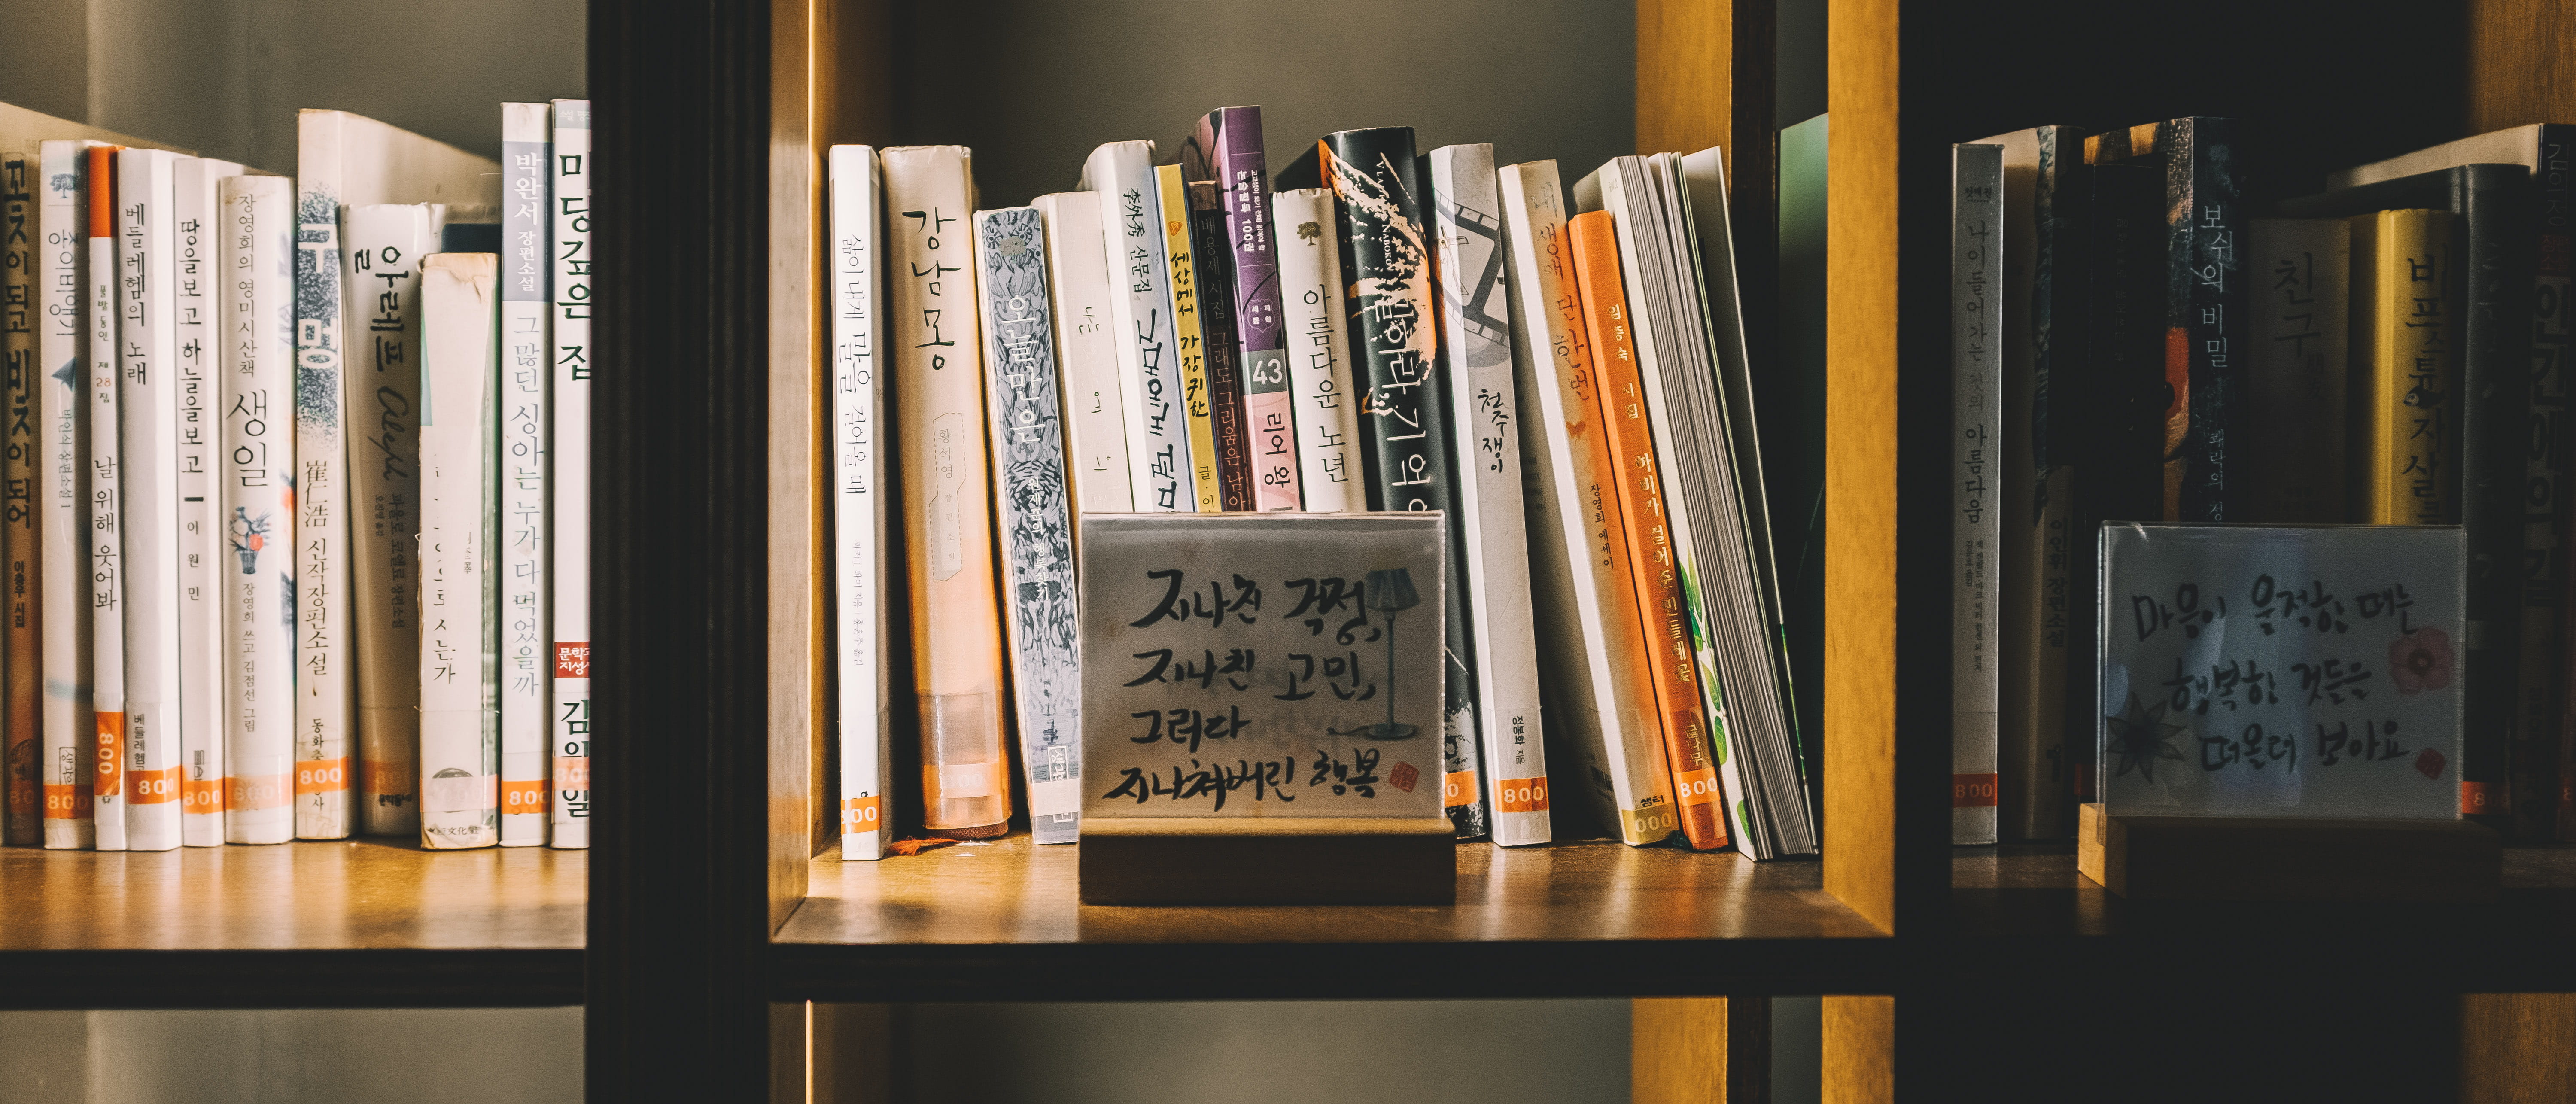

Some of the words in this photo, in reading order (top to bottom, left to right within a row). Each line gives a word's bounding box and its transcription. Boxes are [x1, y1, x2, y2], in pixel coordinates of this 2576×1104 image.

[514, 152, 543, 226] 박완서
[1122, 186, 1146, 238] 李外秀
[1237, 170, 1252, 213] 논술필독
[237, 194, 256, 273] 장영희의
[842, 233, 865, 274] 삶이
[1200, 215, 1220, 275] 배용제
[1241, 218, 1255, 252] 100권
[125, 204, 146, 327] 베들레헴의
[515, 230, 536, 292] 장편소설
[1129, 245, 1153, 294] 산문집
[1170, 251, 1194, 317] 세상에서
[5, 284, 30, 335] 되고
[354, 246, 409, 372] 알레프
[843, 280, 865, 320] 내게
[902, 206, 961, 371] 강남몽
[1208, 280, 1224, 320] 시집
[2274, 252, 2321, 357] 친구
[514, 317, 540, 334] 그
[1303, 283, 1341, 410] 아름다운
[2201, 304, 2229, 368] 비밀
[126, 341, 146, 385] 노래
[515, 342, 540, 392] 많던
[839, 332, 871, 395] 말을
[1001, 294, 1046, 443] 오늘만은
[1180, 334, 1202, 372] 가장
[1210, 331, 1232, 386] 그래도
[1252, 359, 1282, 385] 43
[1186, 377, 1209, 417] 귀한
[226, 389, 268, 487] 생일
[510, 403, 544, 491] 싱아는
[843, 404, 867, 468] 걸어올
[1218, 390, 1240, 468] 그리움은
[1263, 412, 1287, 455] 리어
[1477, 388, 1509, 474] 천주쟁이
[58, 450, 72, 499] 장편소설
[94, 456, 116, 479] 날
[938, 428, 953, 479] 황석영
[1198, 466, 1211, 480] 글
[1264, 465, 1290, 489] 왕
[1317, 425, 1348, 484] 노년
[1963, 422, 1988, 524] 아름다움
[6, 478, 30, 529] 되어
[844, 475, 864, 495] 때
[94, 488, 115, 535] 위해
[513, 500, 541, 551] 누가
[94, 545, 117, 611] 웃어봐
[516, 559, 541, 584] 다
[242, 582, 256, 624] 장영희
[305, 538, 330, 676] 신작장편소설
[391, 584, 406, 629] 장편소설
[1129, 568, 1262, 628] 지나친
[243, 630, 256, 654] 쓰고
[512, 593, 541, 698] 먹었을까
[243, 660, 256, 702] 김점선
[559, 661, 590, 675] 지성
[1123, 648, 1255, 692] 지나친
[243, 709, 256, 733] 그림
[1129, 704, 1253, 754] 그러다
[1512, 715, 1525, 745] 정봉화
[2317, 720, 2411, 767] 보아요
[99, 733, 114, 775] 800
[300, 767, 342, 785] 800
[1310, 748, 1381, 799] 행복
[1515, 749, 1525, 765] 지음
[139, 778, 174, 794] 800
[184, 790, 220, 805] 800
[1503, 786, 1545, 803] 800
[1640, 794, 1664, 808] 샘터
[1679, 776, 1718, 798] 800
[1954, 784, 1993, 798] 800
[1634, 812, 1673, 833] 000
